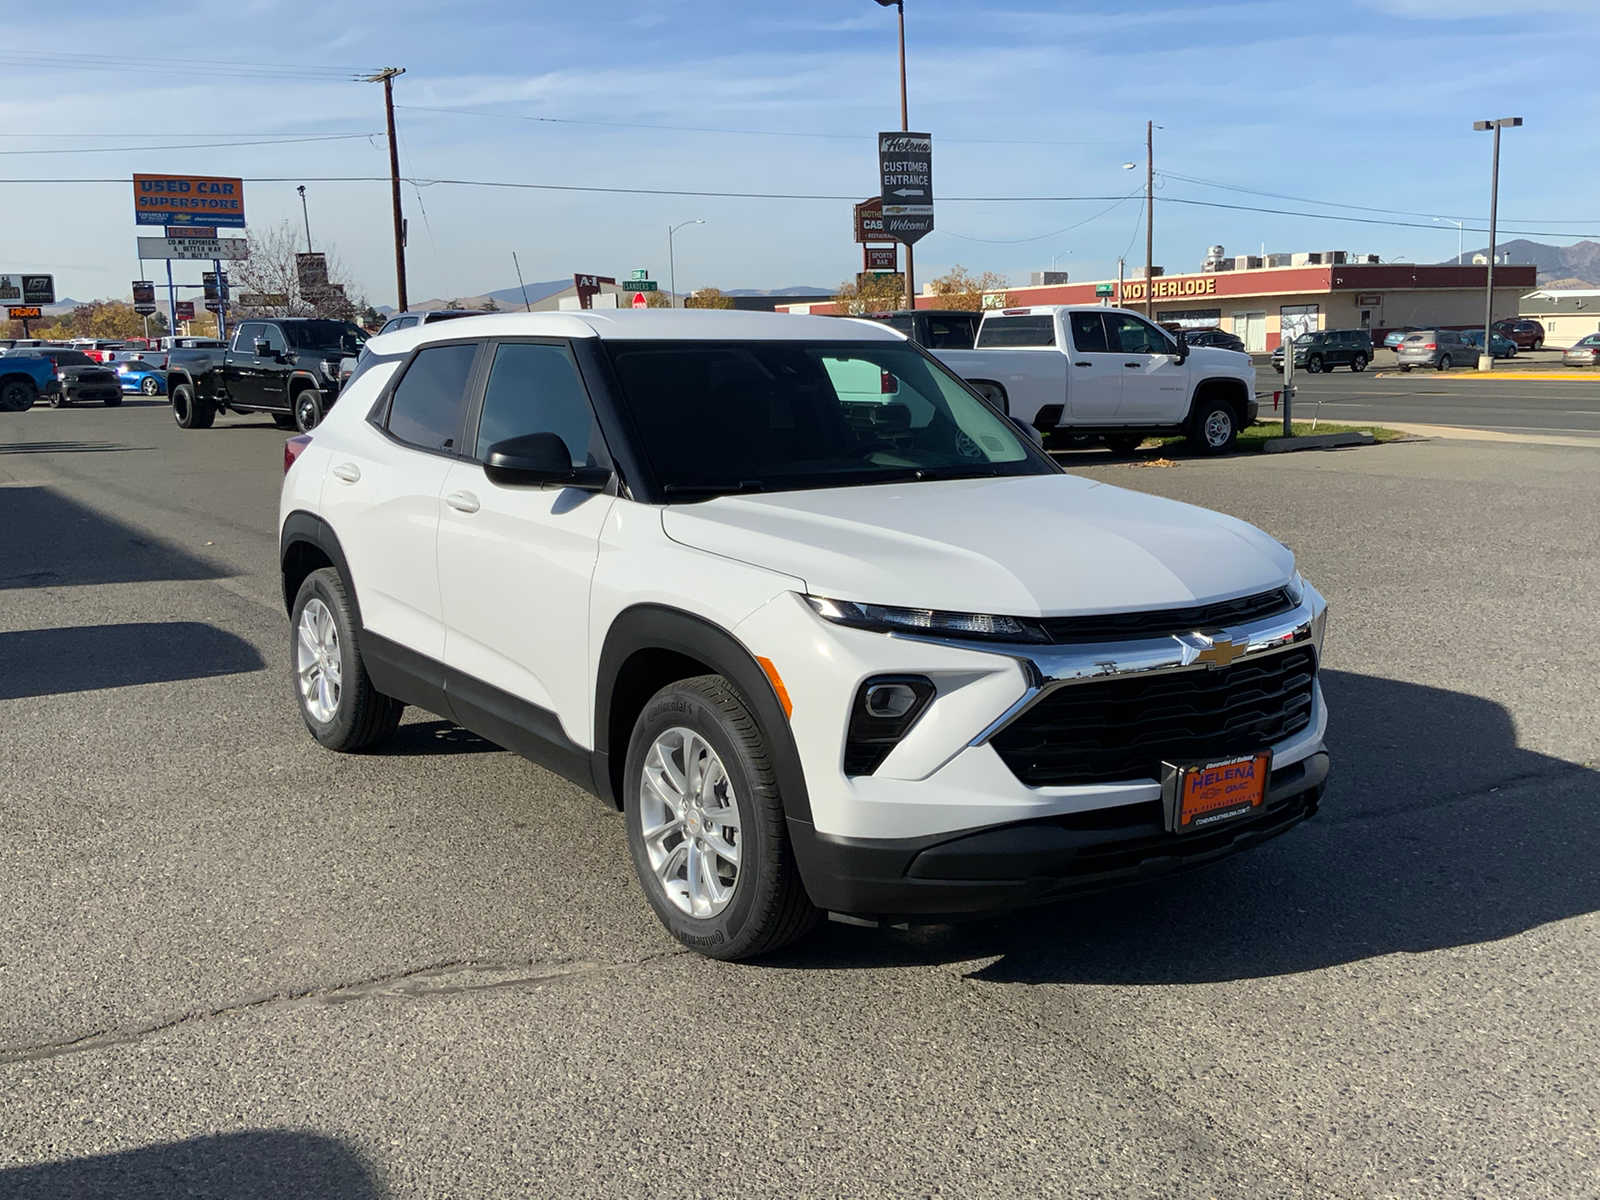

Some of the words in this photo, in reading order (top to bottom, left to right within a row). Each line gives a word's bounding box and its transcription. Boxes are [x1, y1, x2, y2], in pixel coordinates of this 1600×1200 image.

[887, 137, 930, 152] Helena
[883, 161, 929, 172] CUSTOMER
[884, 174, 929, 185] ENTRANCE
[141, 181, 191, 193] USED
[198, 183, 234, 194] CAR
[140, 197, 239, 208] SUPERSTORE
[890, 218, 929, 231] Welcome!
[1122, 279, 1217, 299] MOTHERLODE
[1192, 765, 1255, 793] HELENA
